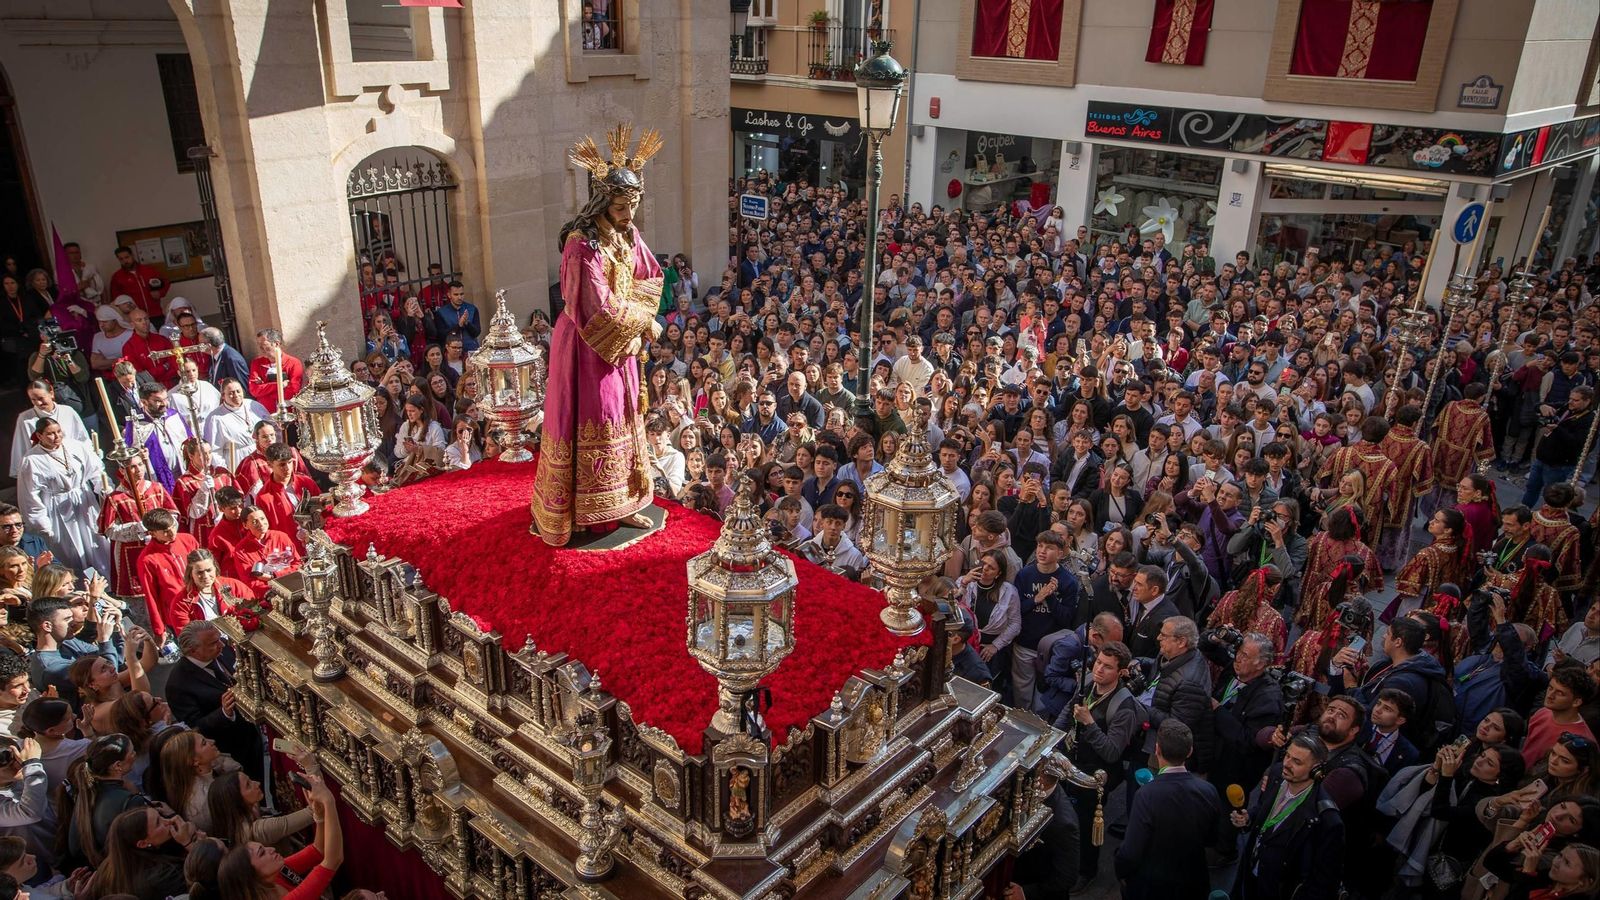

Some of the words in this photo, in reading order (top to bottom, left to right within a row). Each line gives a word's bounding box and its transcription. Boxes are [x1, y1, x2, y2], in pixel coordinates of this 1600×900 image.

[745, 111, 781, 127] Lashes
[785, 114, 794, 128] &
[798, 116, 814, 136] Go
[1089, 112, 1121, 120] TEJIDOS
[1087, 121, 1127, 135] Buenos
[1131, 125, 1162, 139] Aires
[988, 134, 1015, 153] cybex
